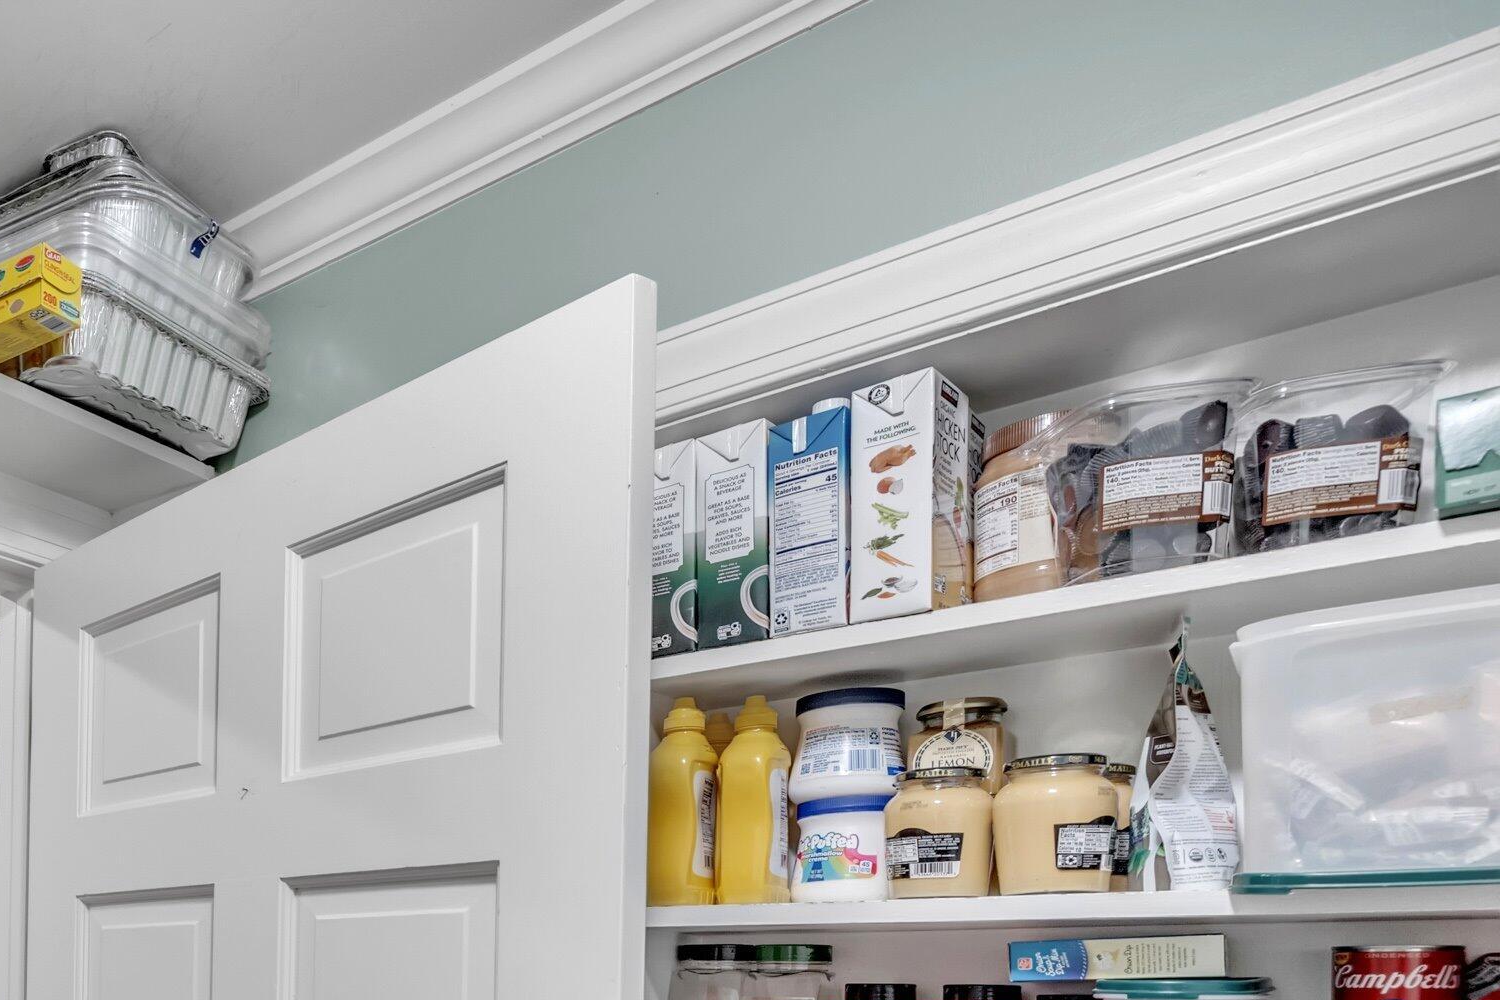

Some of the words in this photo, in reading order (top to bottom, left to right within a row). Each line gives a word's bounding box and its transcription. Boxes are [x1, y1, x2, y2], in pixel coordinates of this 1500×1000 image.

[874, 425, 892, 435] MADE
[893, 420, 910, 429] WITH
[866, 436, 878, 444] THE
[1302, 449, 1322, 457] Facts
[775, 455, 812, 471] Nutrition
[814, 449, 838, 461] Facts
[1106, 463, 1135, 474] Nutrition
[1135, 460, 1152, 468] Facts
[712, 475, 739, 485] DELICIOUS
[719, 481, 736, 490] SNACK
[775, 484, 802, 497] Calories
[825, 473, 838, 482] 45
[998, 477, 1018, 489] Facts
[716, 485, 741, 495] BEVERAGE
[708, 501, 723, 510] GREAT
[737, 494, 750, 502] BASE
[1000, 495, 1018, 507] 190
[731, 507, 751, 516] SAUCES
[728, 514, 743, 522] MORE
[730, 526, 742, 534] RICH
[931, 756, 976, 768] LEMON
[1124, 956, 1133, 975] Onion
